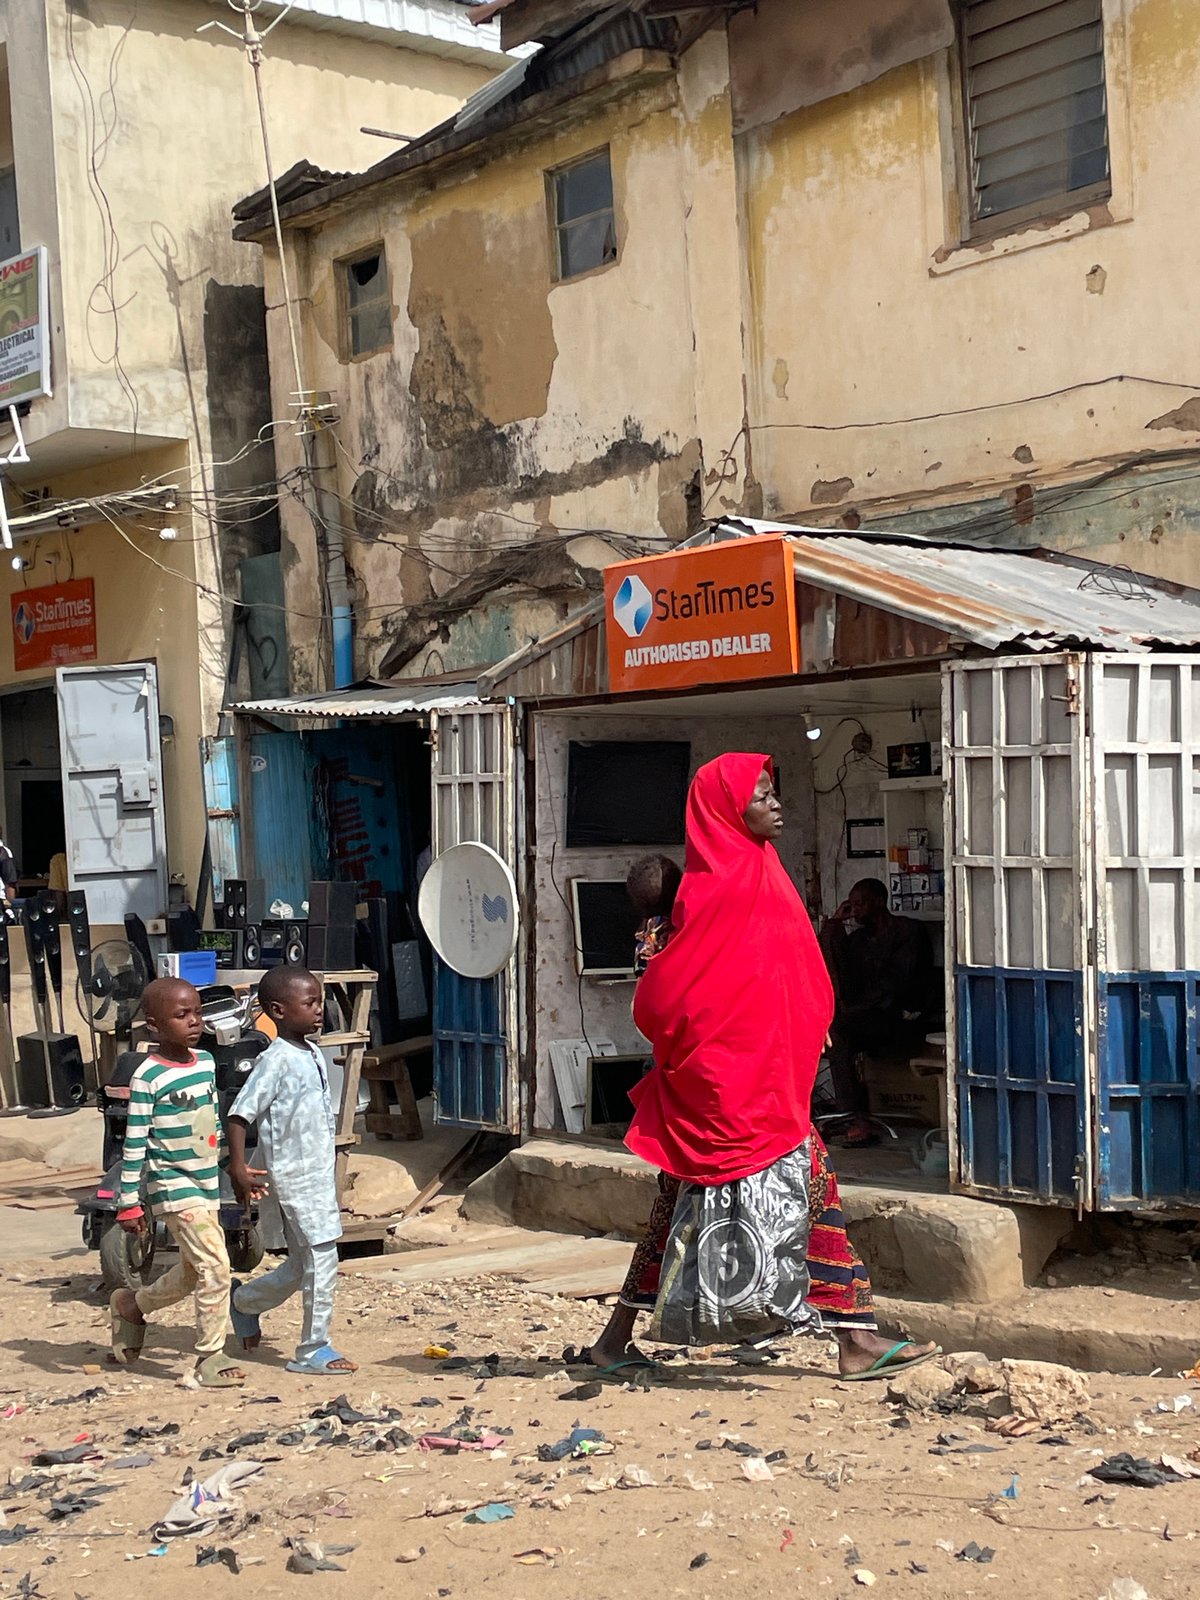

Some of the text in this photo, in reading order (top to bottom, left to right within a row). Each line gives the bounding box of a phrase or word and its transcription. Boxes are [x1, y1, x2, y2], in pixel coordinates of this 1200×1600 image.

[35, 597, 92, 622] StarTimes
[654, 580, 775, 622] StarTimes
[624, 632, 772, 668] AUTHORISED DEALER
